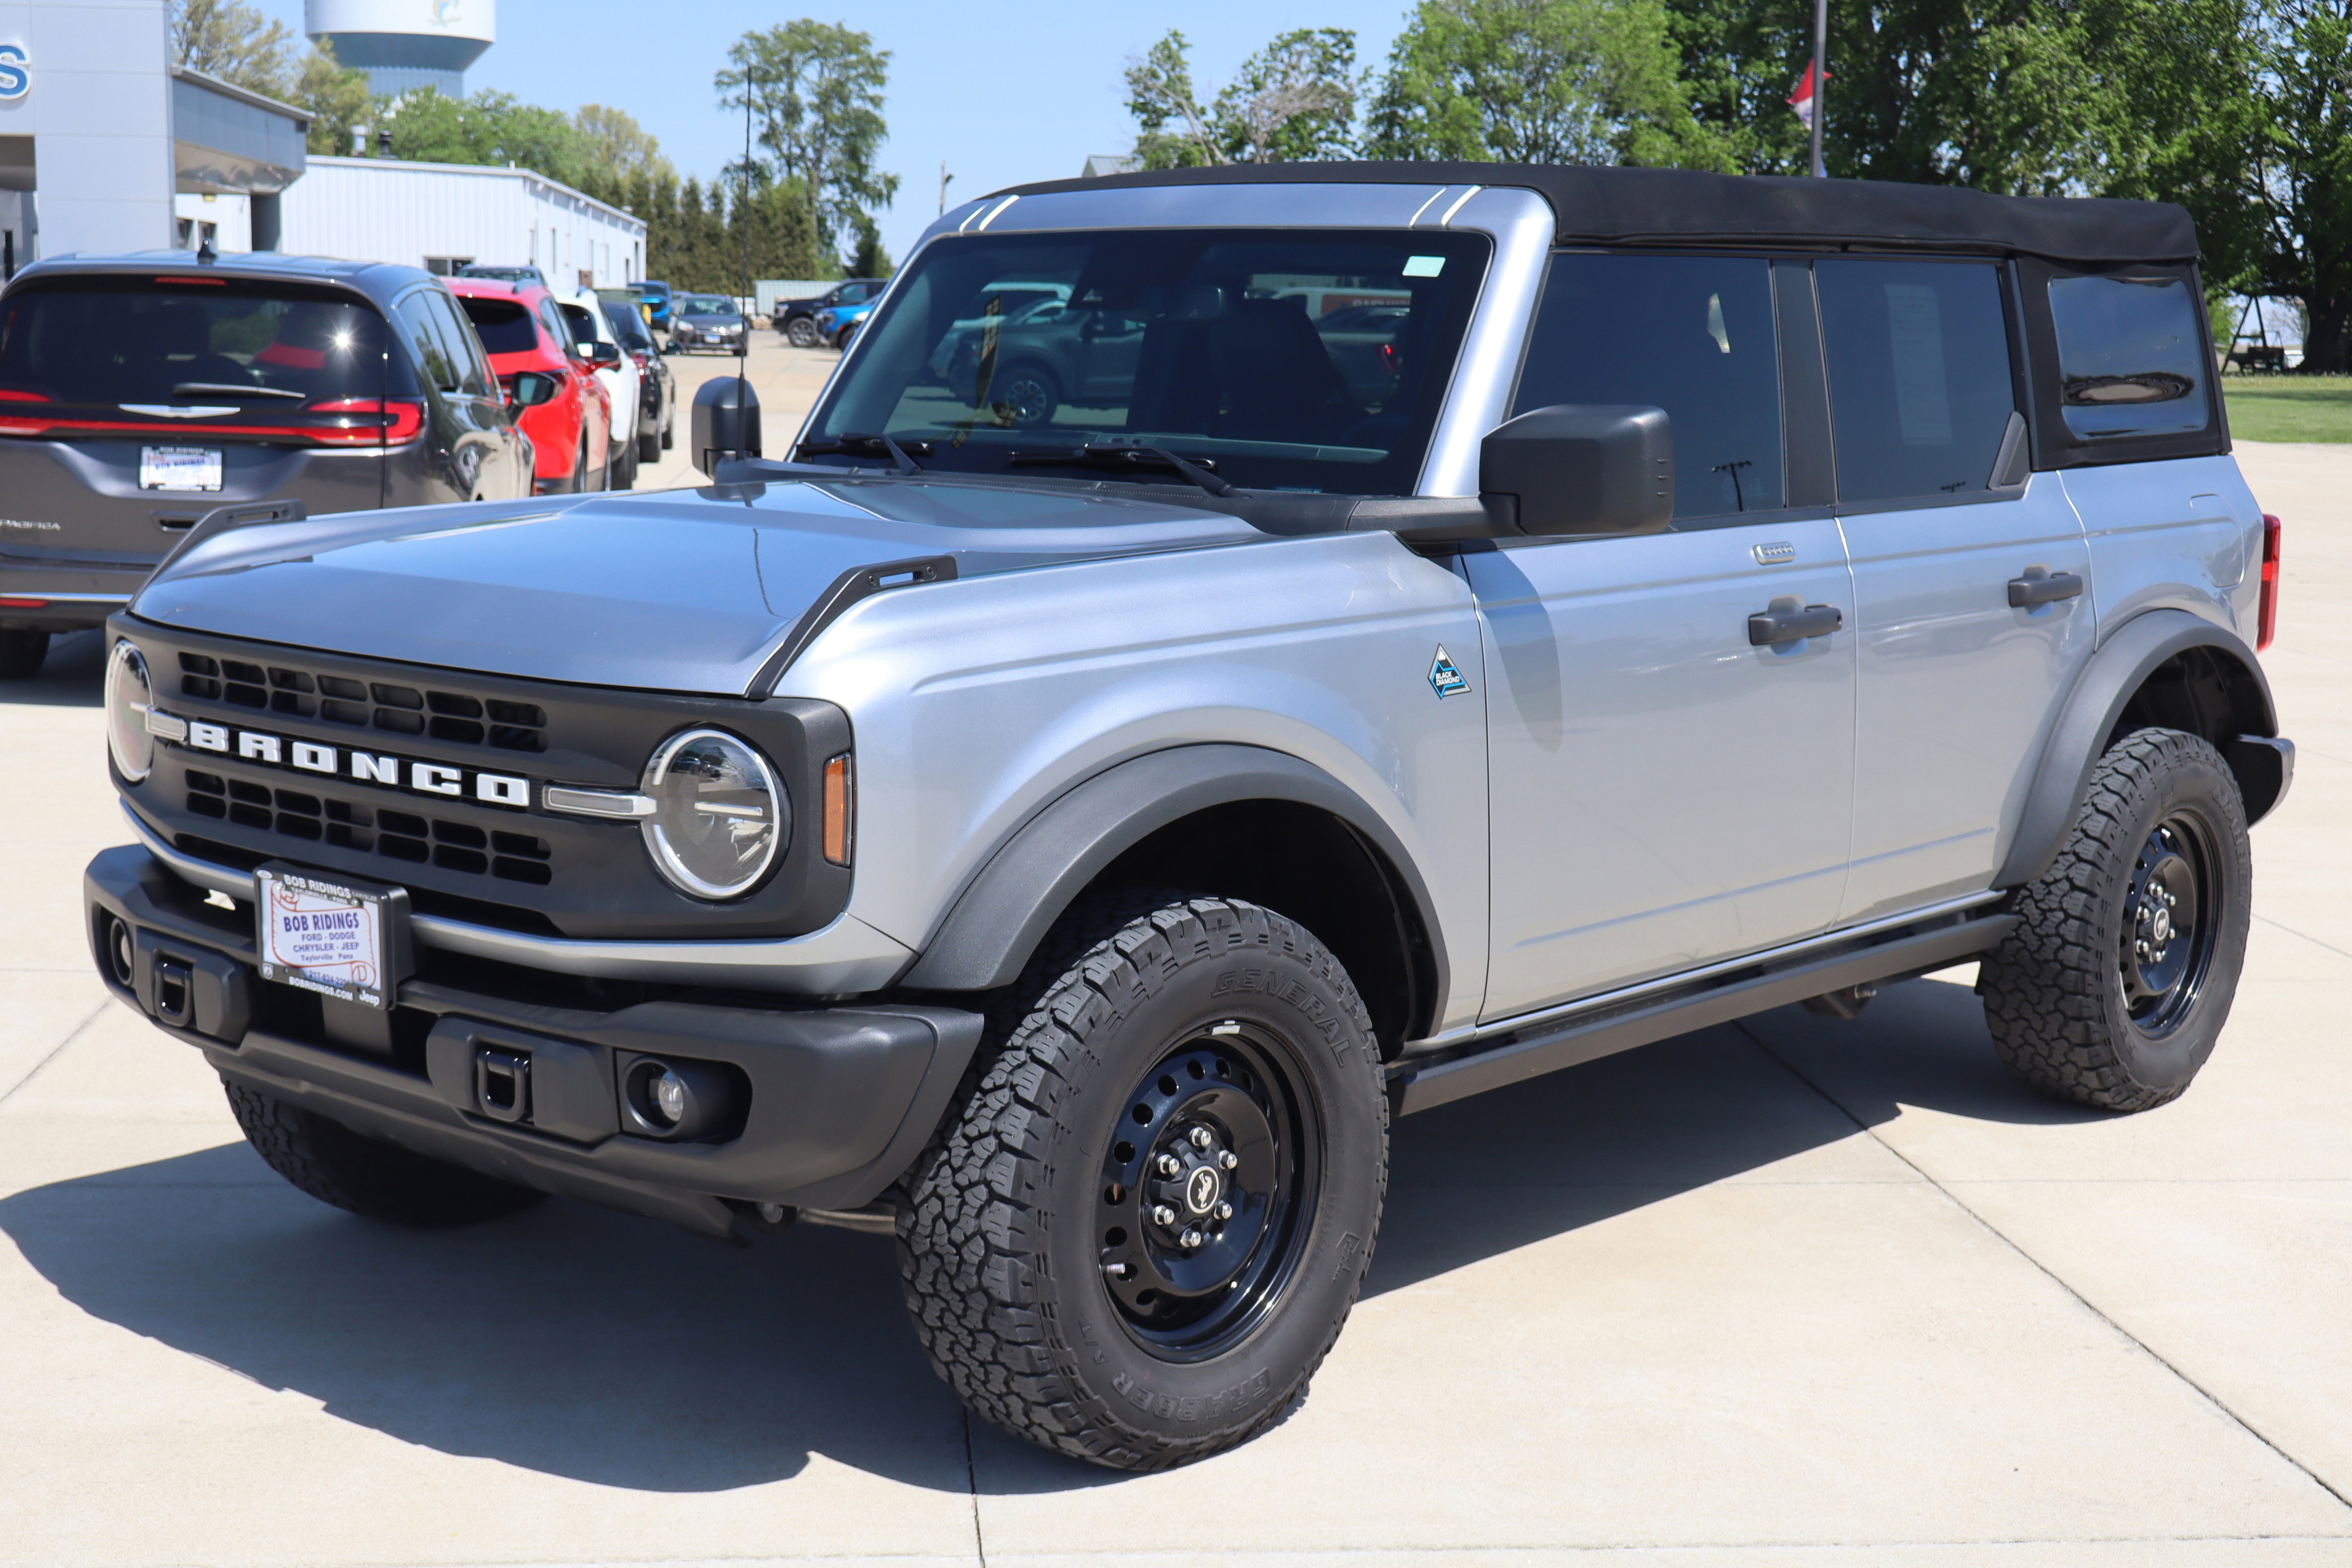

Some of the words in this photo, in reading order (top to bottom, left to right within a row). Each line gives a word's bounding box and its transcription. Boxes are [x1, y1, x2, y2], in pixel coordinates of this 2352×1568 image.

[1436, 670, 1452, 679] BLACK
[1436, 676, 1460, 686] DIAMOND
[189, 721, 530, 807] BRONCO
[283, 874, 306, 889] BOB
[307, 879, 352, 899] RIDINGS
[352, 891, 378, 902] CHRYSLER
[283, 915, 309, 932] BOB
[312, 912, 359, 930] RIDINGS
[329, 931, 356, 940] DODGE
[293, 943, 334, 953] CHRYSLER
[341, 942, 359, 950] JEEP
[301, 953, 333, 962] Taylorville
[288, 976, 353, 1001] BOBRIDINGS.COM
[359, 989, 380, 1007] Jeep
[1211, 969, 1352, 1069] GENERAL
[1110, 1366, 1272, 1422] GRABBER
